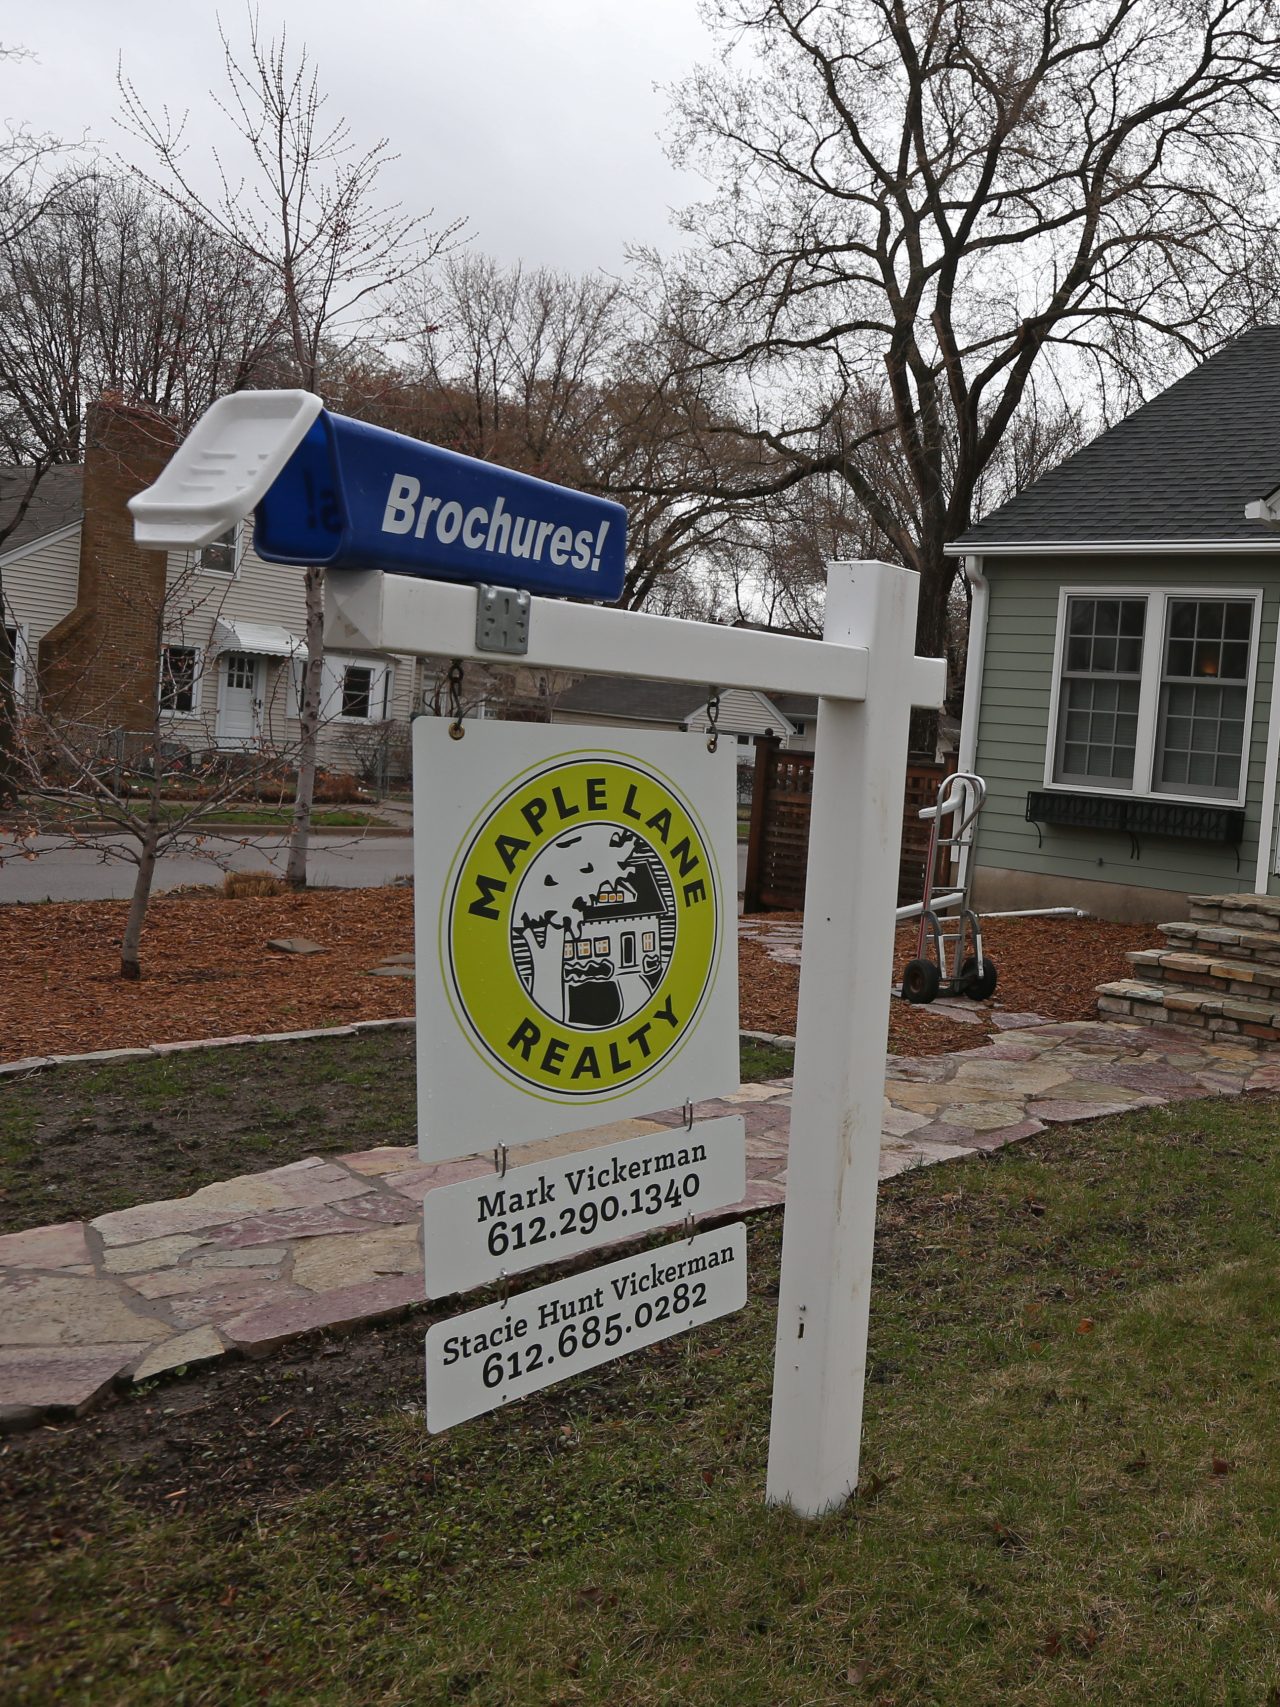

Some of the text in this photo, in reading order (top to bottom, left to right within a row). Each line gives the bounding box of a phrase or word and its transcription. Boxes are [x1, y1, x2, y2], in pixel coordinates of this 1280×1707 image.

[381, 473, 610, 572] Brochures!
[468, 778, 707, 920] MAPLE LANE
[507, 994, 680, 1080] REALTY
[478, 1144, 707, 1223] Mark Vickerman
[488, 1172, 700, 1257] 612.290.1340
[443, 1246, 735, 1366] Stacie Hunt Vickerman
[482, 1282, 708, 1389] 612.685.0282
